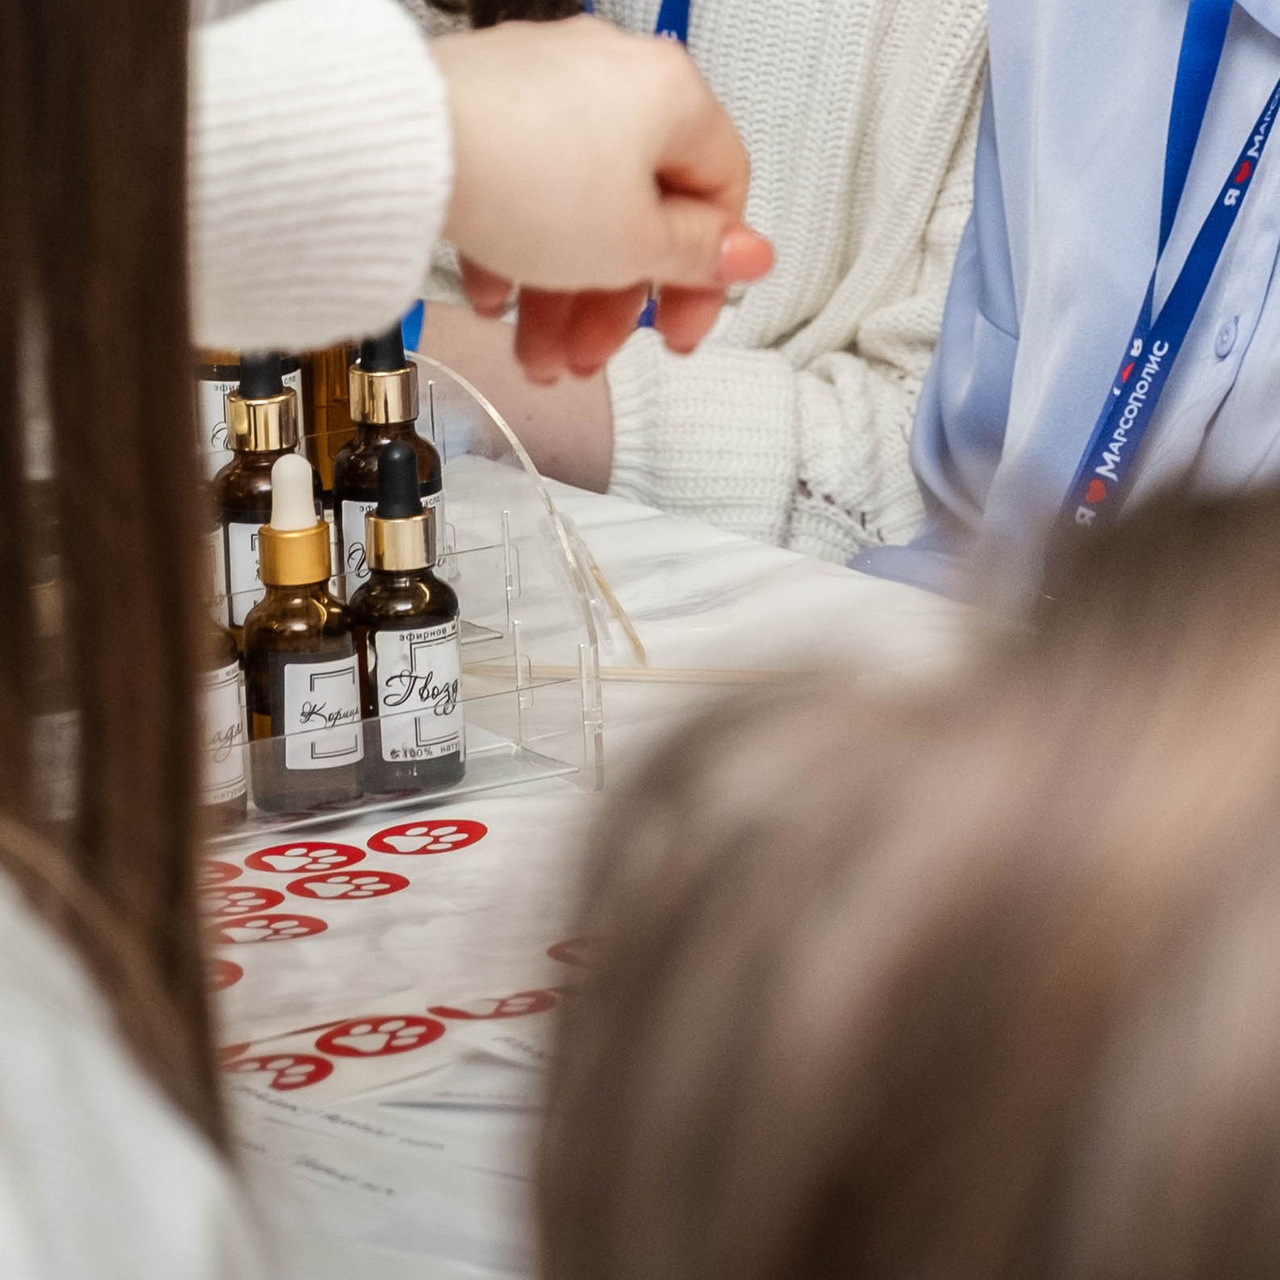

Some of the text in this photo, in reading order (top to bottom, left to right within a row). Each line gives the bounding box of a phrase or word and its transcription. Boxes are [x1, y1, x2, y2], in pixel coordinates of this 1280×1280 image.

[1223, 188, 1240, 206] Я
[1075, 506, 1096, 527] Я
[400, 627, 447, 641] эфирное
